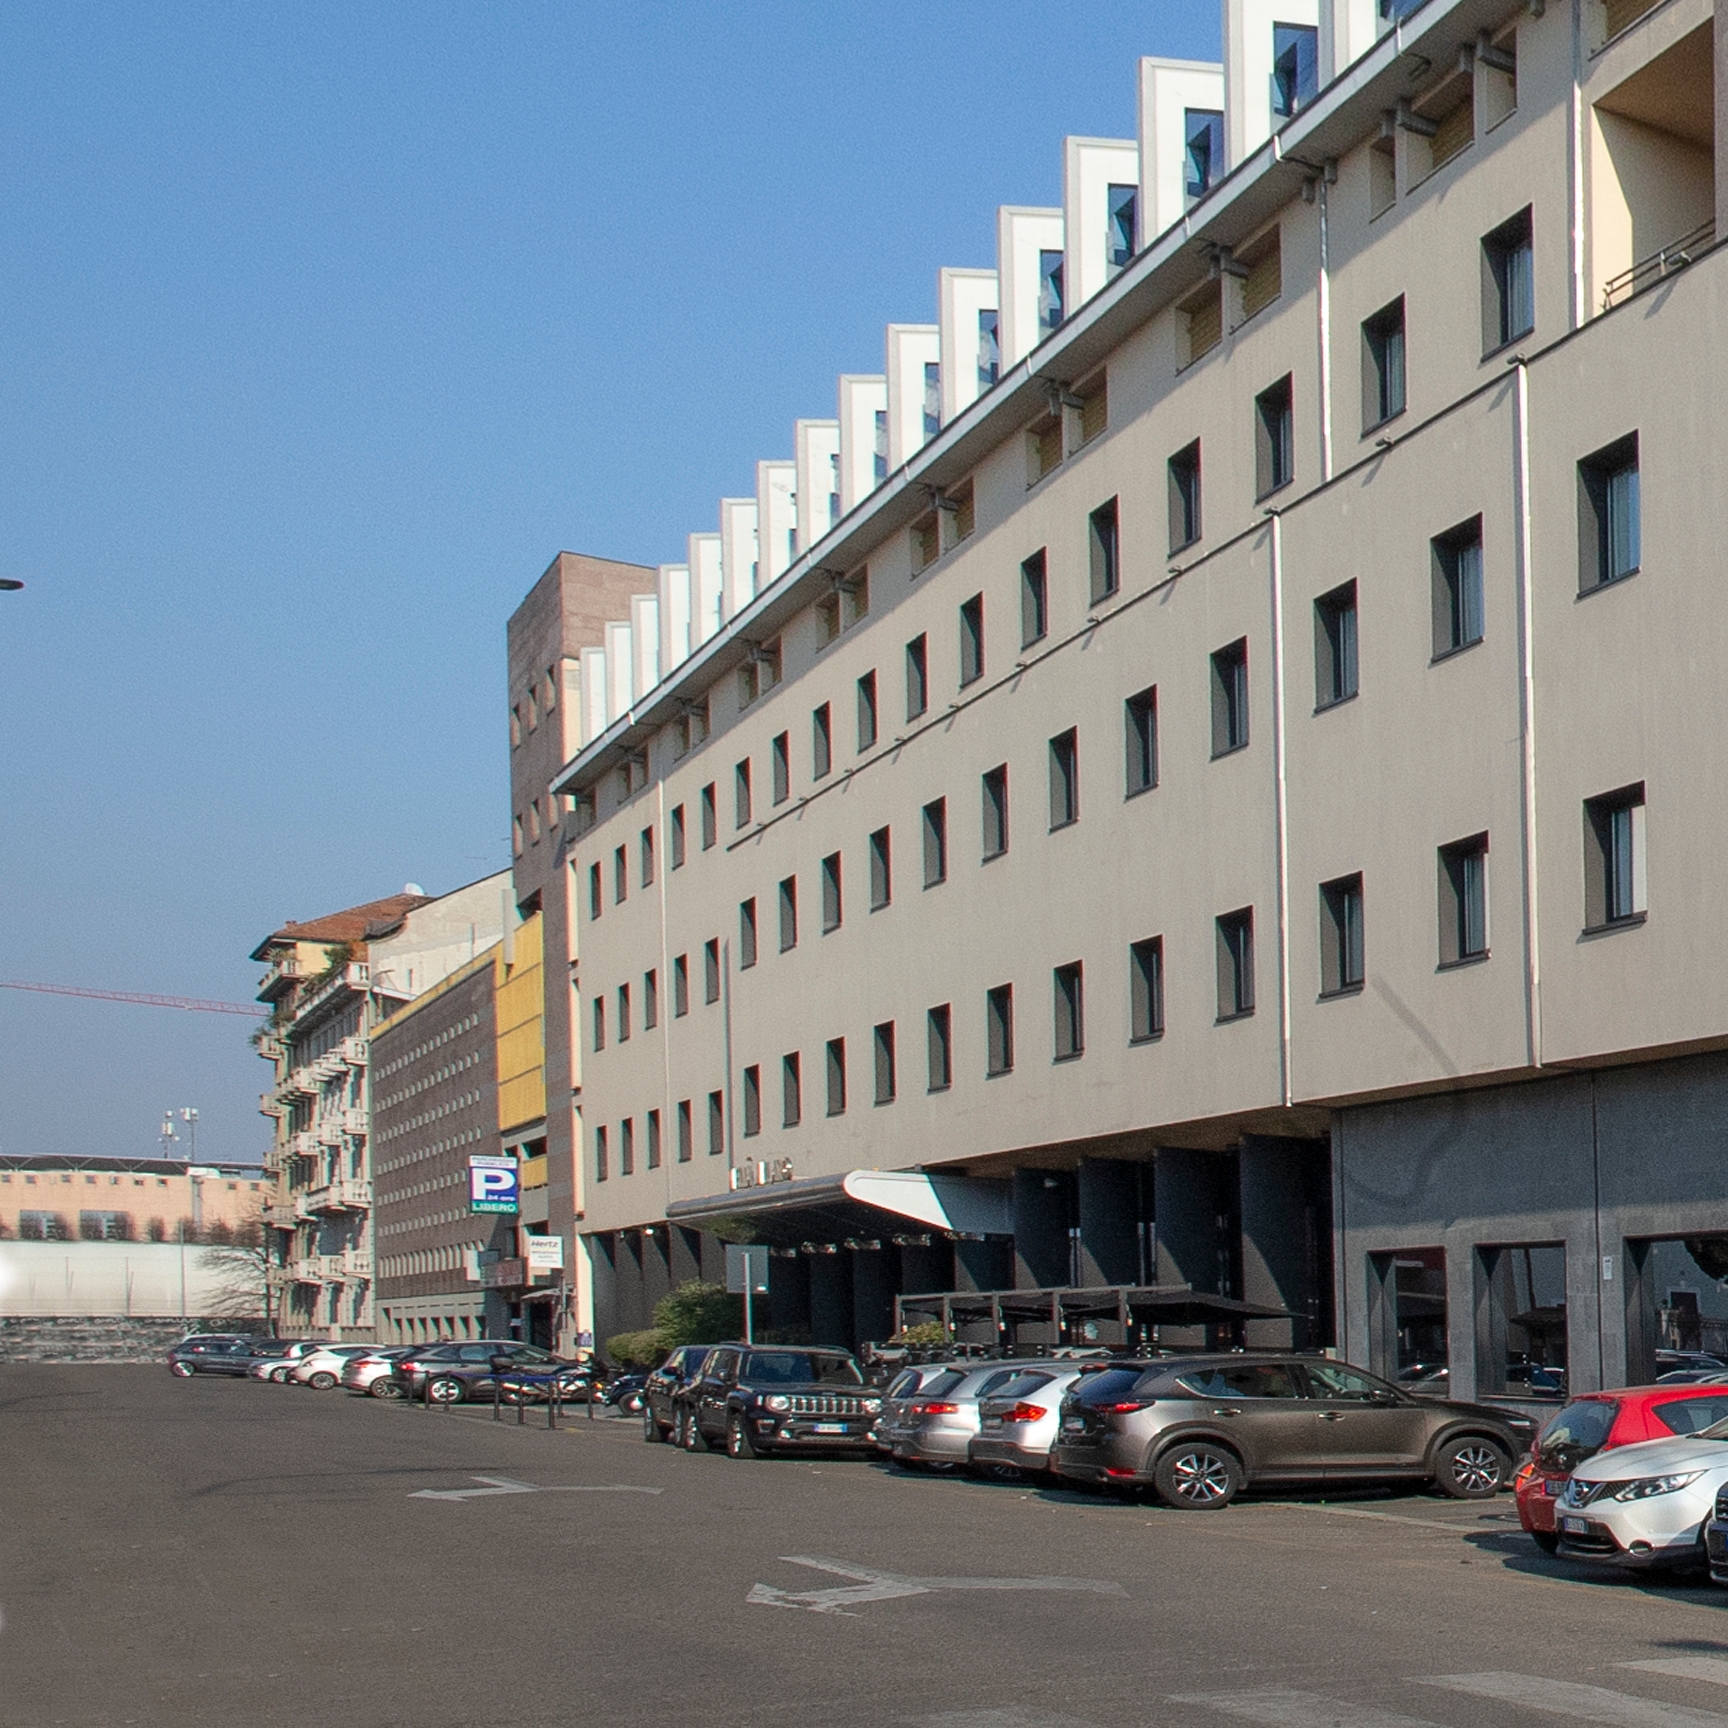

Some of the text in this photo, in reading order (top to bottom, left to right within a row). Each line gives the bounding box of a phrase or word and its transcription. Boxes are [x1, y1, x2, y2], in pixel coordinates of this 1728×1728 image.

[472, 1168, 516, 1200] P
[471, 1202, 516, 1213] LIBERO
[531, 1239, 559, 1248] Hertz
